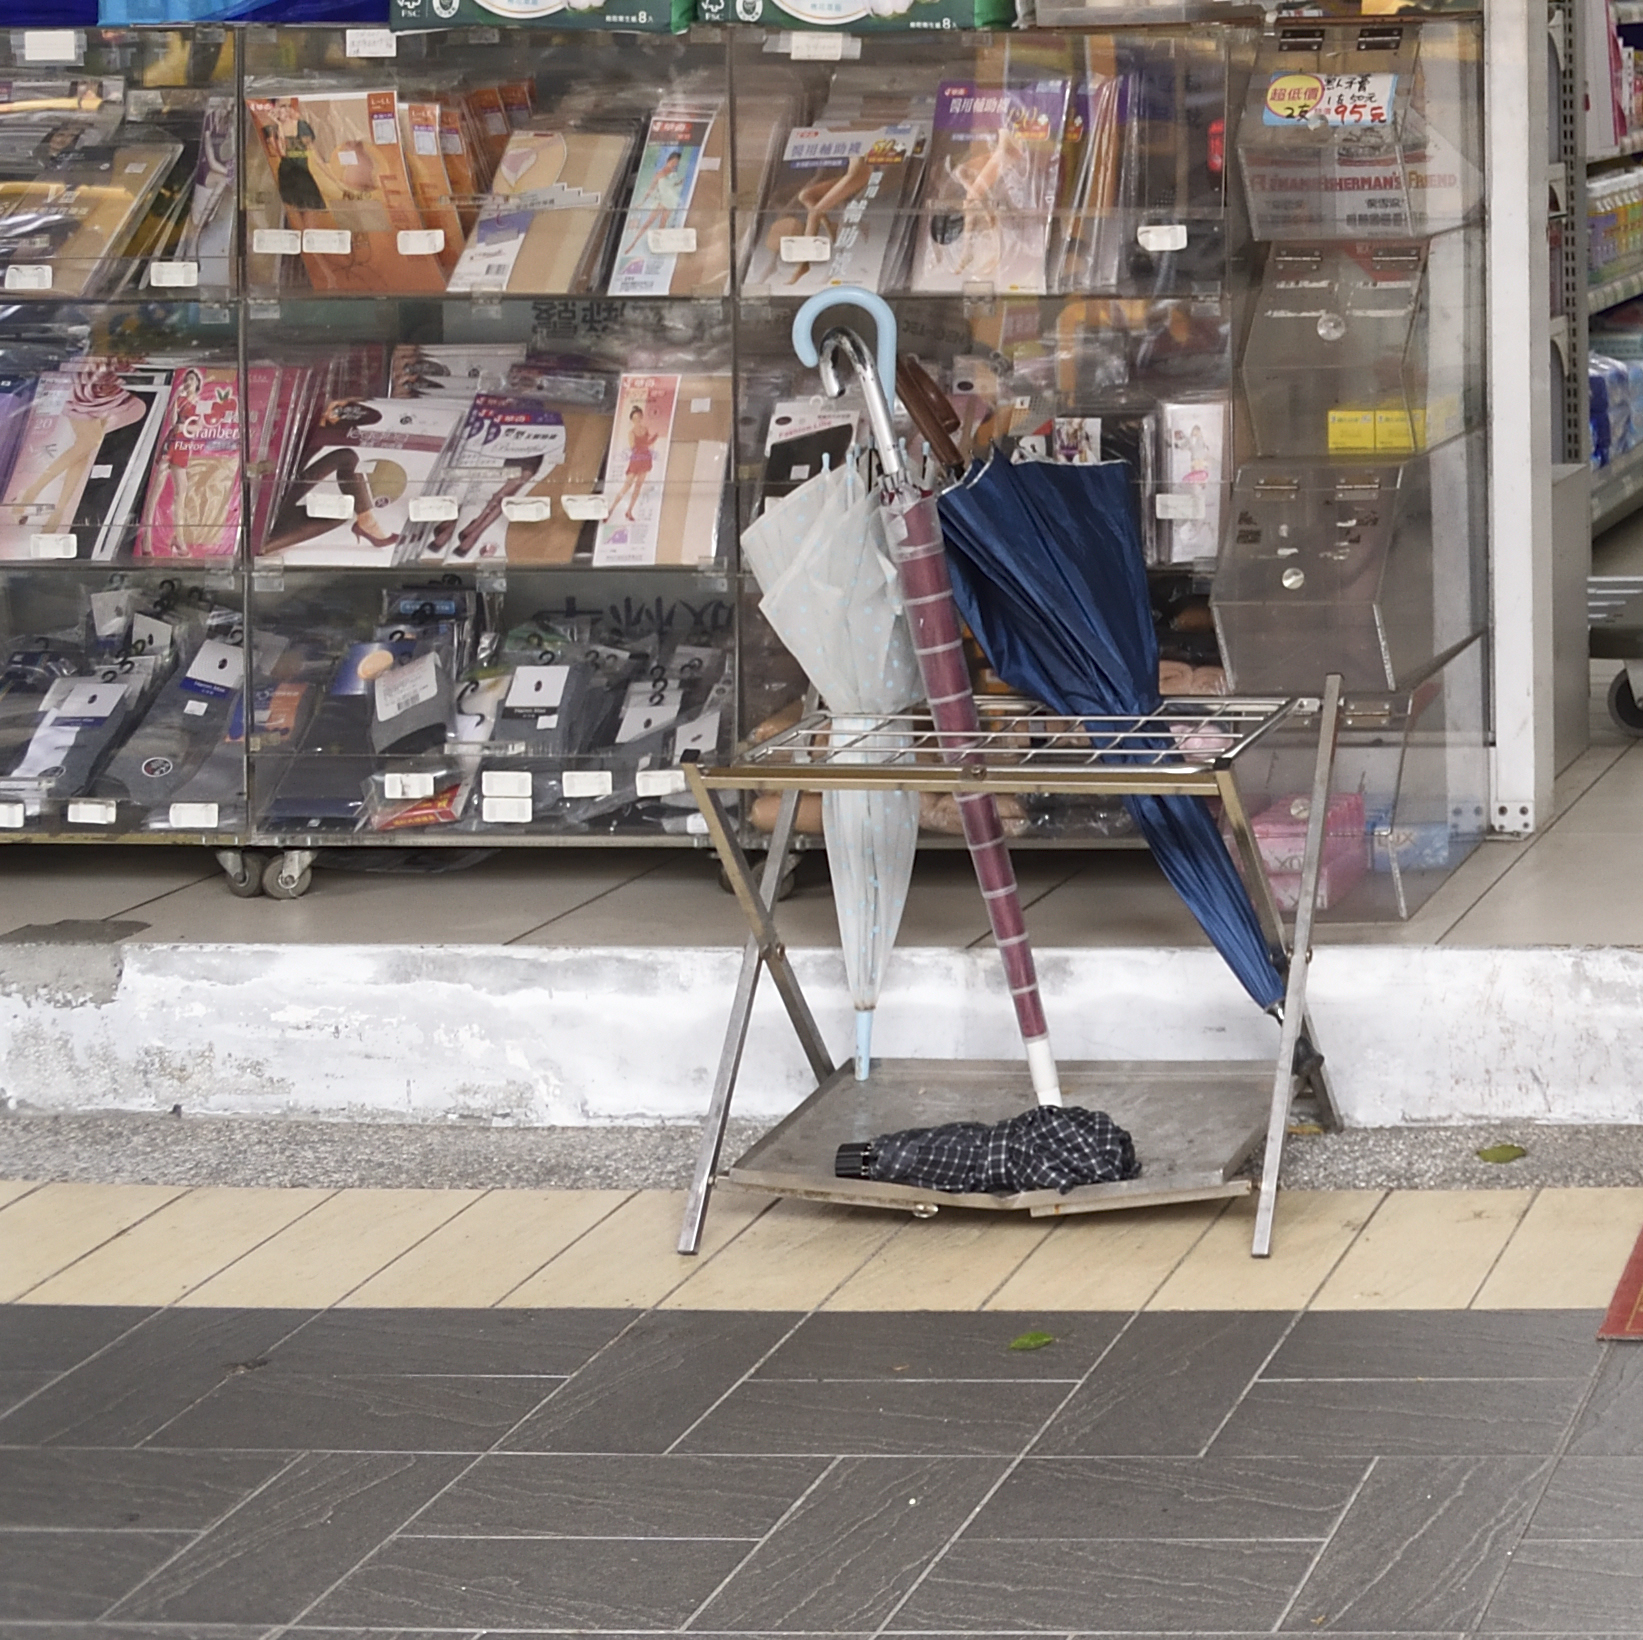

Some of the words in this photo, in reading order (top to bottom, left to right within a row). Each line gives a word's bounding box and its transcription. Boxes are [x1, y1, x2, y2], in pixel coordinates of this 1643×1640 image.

[401, 10, 420, 18] FSC
[705, 13, 724, 21] FSC
[1324, 75, 1371, 91] 黑人牙膏
[1269, 87, 1319, 101] 超低價
[1334, 104, 1386, 124] 95元
[1408, 171, 1457, 188] FRIEND
[174, 441, 204, 451] Flavor
